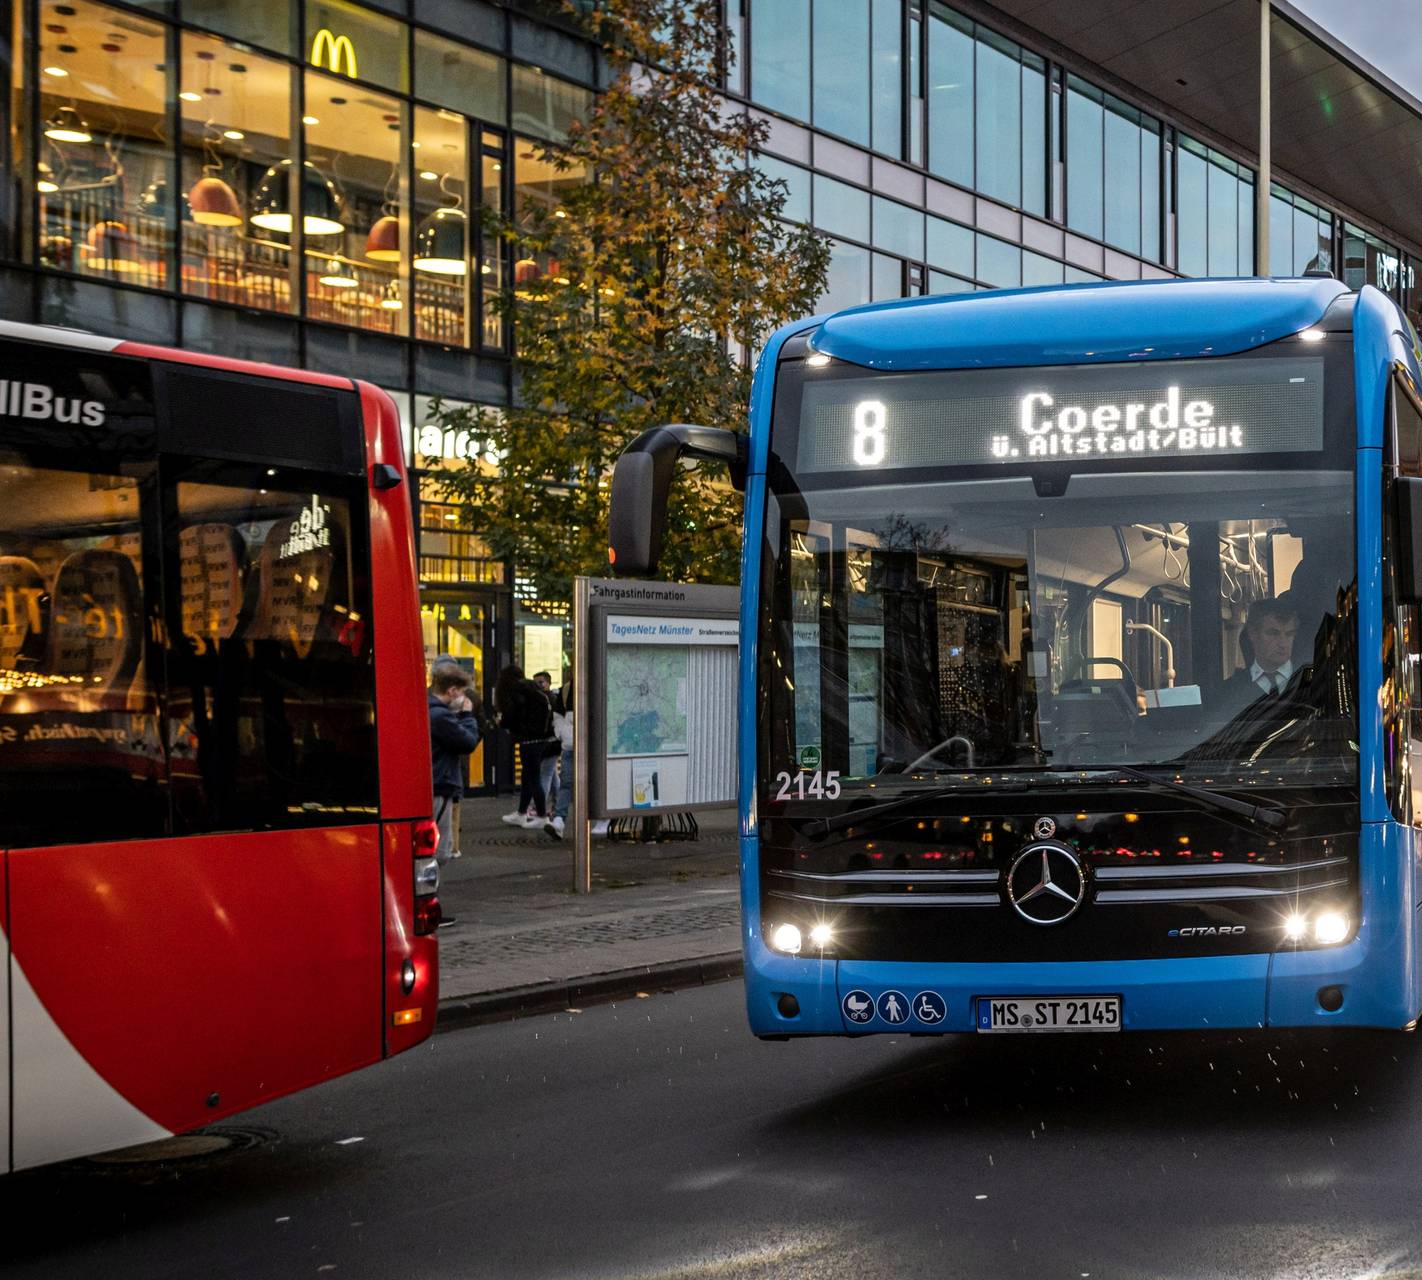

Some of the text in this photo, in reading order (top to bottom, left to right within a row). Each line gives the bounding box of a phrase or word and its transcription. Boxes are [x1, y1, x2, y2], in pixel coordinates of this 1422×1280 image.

[1021, 386, 1215, 435] Coerde
[853, 400, 888, 465] 8
[1029, 424, 1244, 456] Altstadt/Bült
[593, 585, 686, 601] Fahrgastinformation
[611, 624, 694, 637] TagesNetz Münster
[776, 771, 841, 800] 2145
[1168, 926, 1246, 937] eCITARO
[993, 1001, 1118, 1026] MS ST 2145
